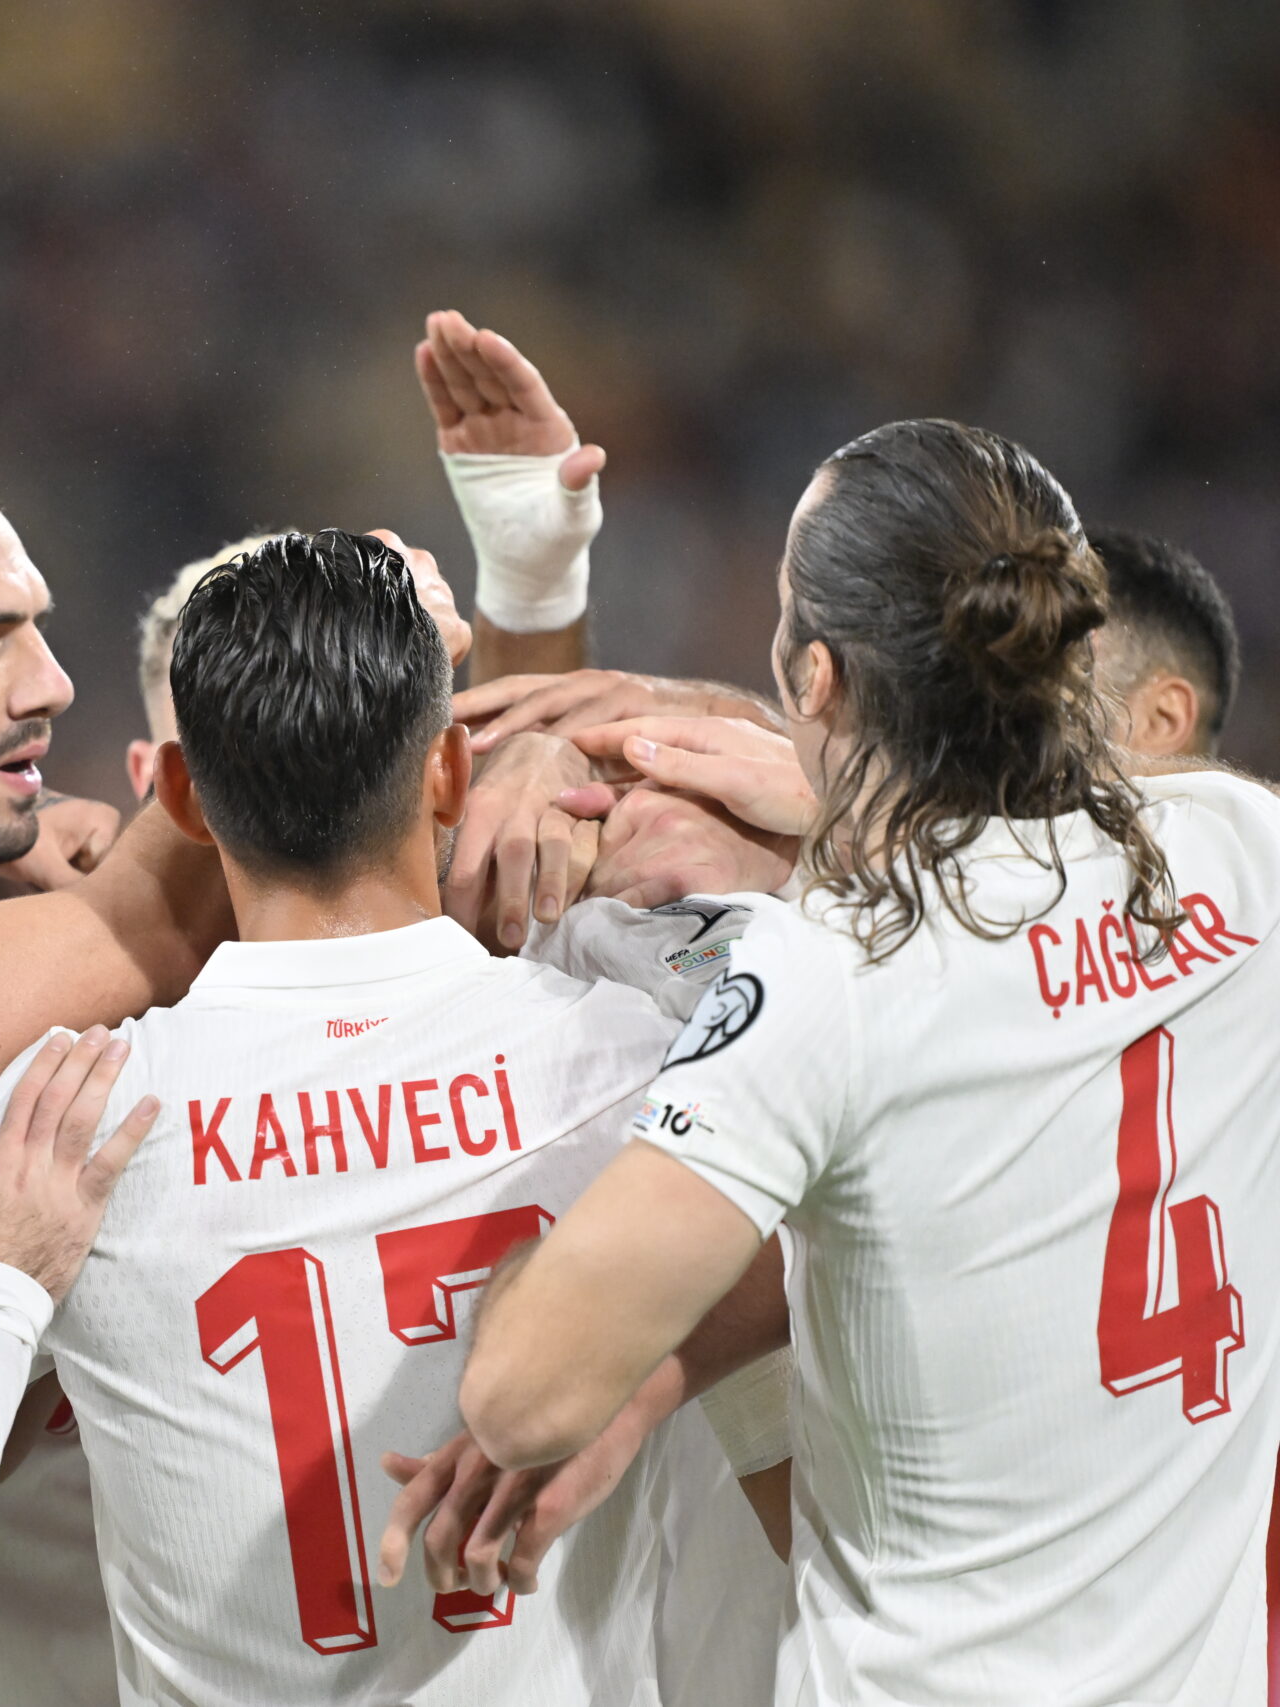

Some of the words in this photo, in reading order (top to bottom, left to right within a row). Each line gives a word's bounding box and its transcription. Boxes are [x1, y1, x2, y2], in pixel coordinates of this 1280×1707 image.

[665, 948, 690, 963] UEFA
[1027, 892, 1260, 1019] ÇAĞLAR
[326, 1017, 390, 1038] TÜRKİ
[187, 1053, 523, 1186] KAHVECİ
[1096, 1024, 1246, 1425] 4
